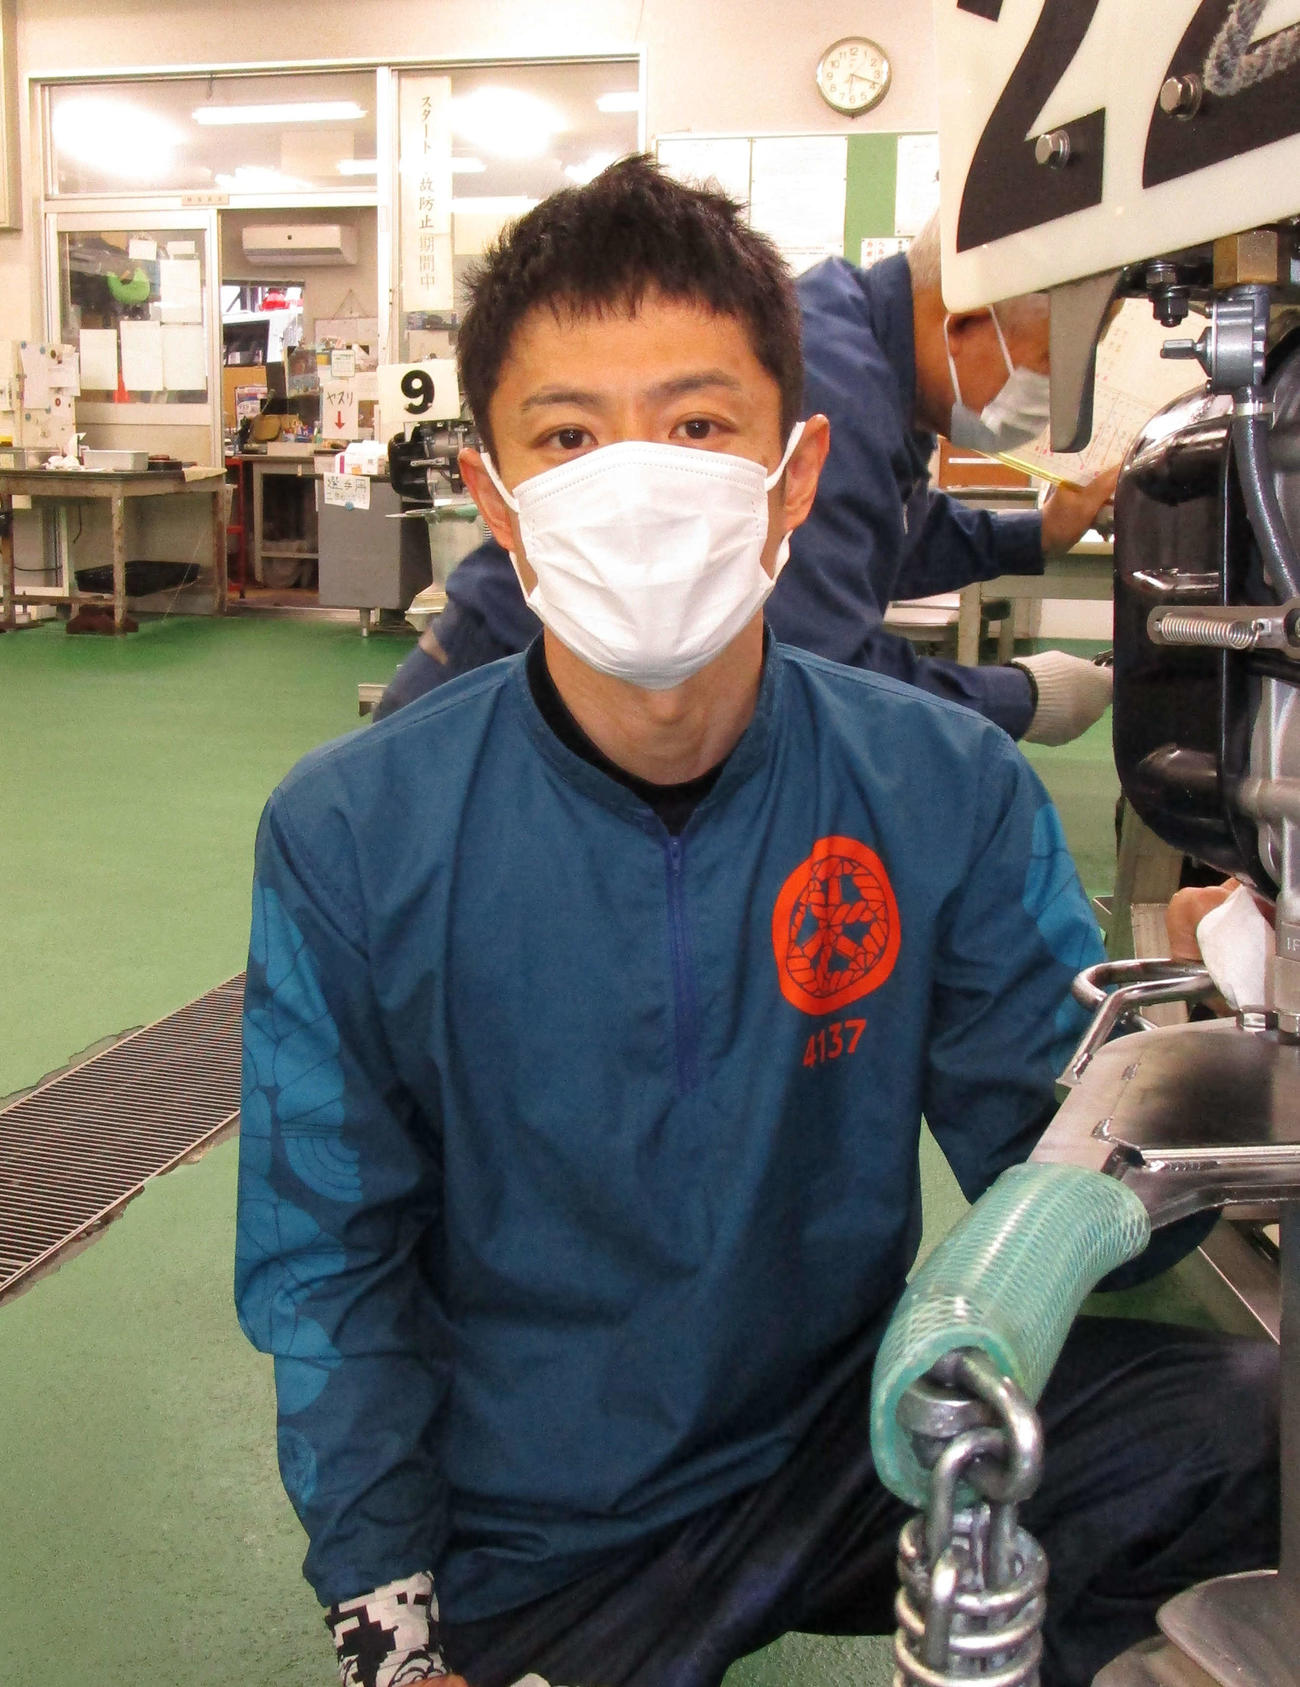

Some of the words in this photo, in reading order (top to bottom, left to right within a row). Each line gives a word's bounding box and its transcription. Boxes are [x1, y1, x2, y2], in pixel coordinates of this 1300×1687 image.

[849, 47, 859, 55] 12
[326, 391, 353, 407] ヤスリ
[401, 369, 435, 415] 9
[803, 1019, 867, 1068] 4137
